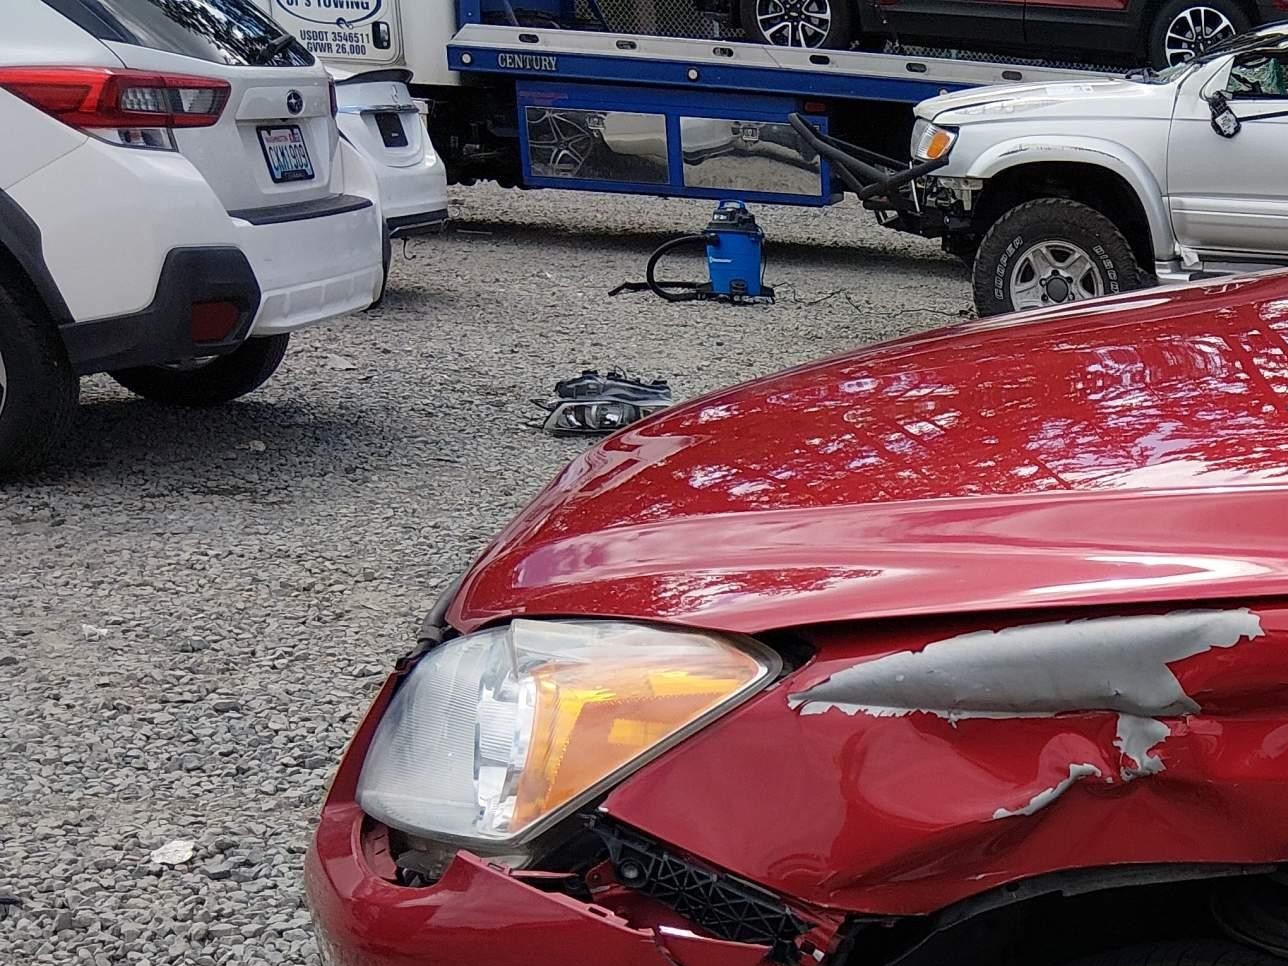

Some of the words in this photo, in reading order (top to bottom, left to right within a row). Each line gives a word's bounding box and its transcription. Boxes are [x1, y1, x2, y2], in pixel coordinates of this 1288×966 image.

[300, 30, 328, 41] USDOT
[331, 32, 370, 43] 3546511
[306, 42, 333, 53] GVWR
[335, 44, 366, 55] 26,000
[498, 53, 557, 70] CENTURY
[994, 236, 1024, 300] COOPER
[1093, 245, 1120, 295] DISCO
